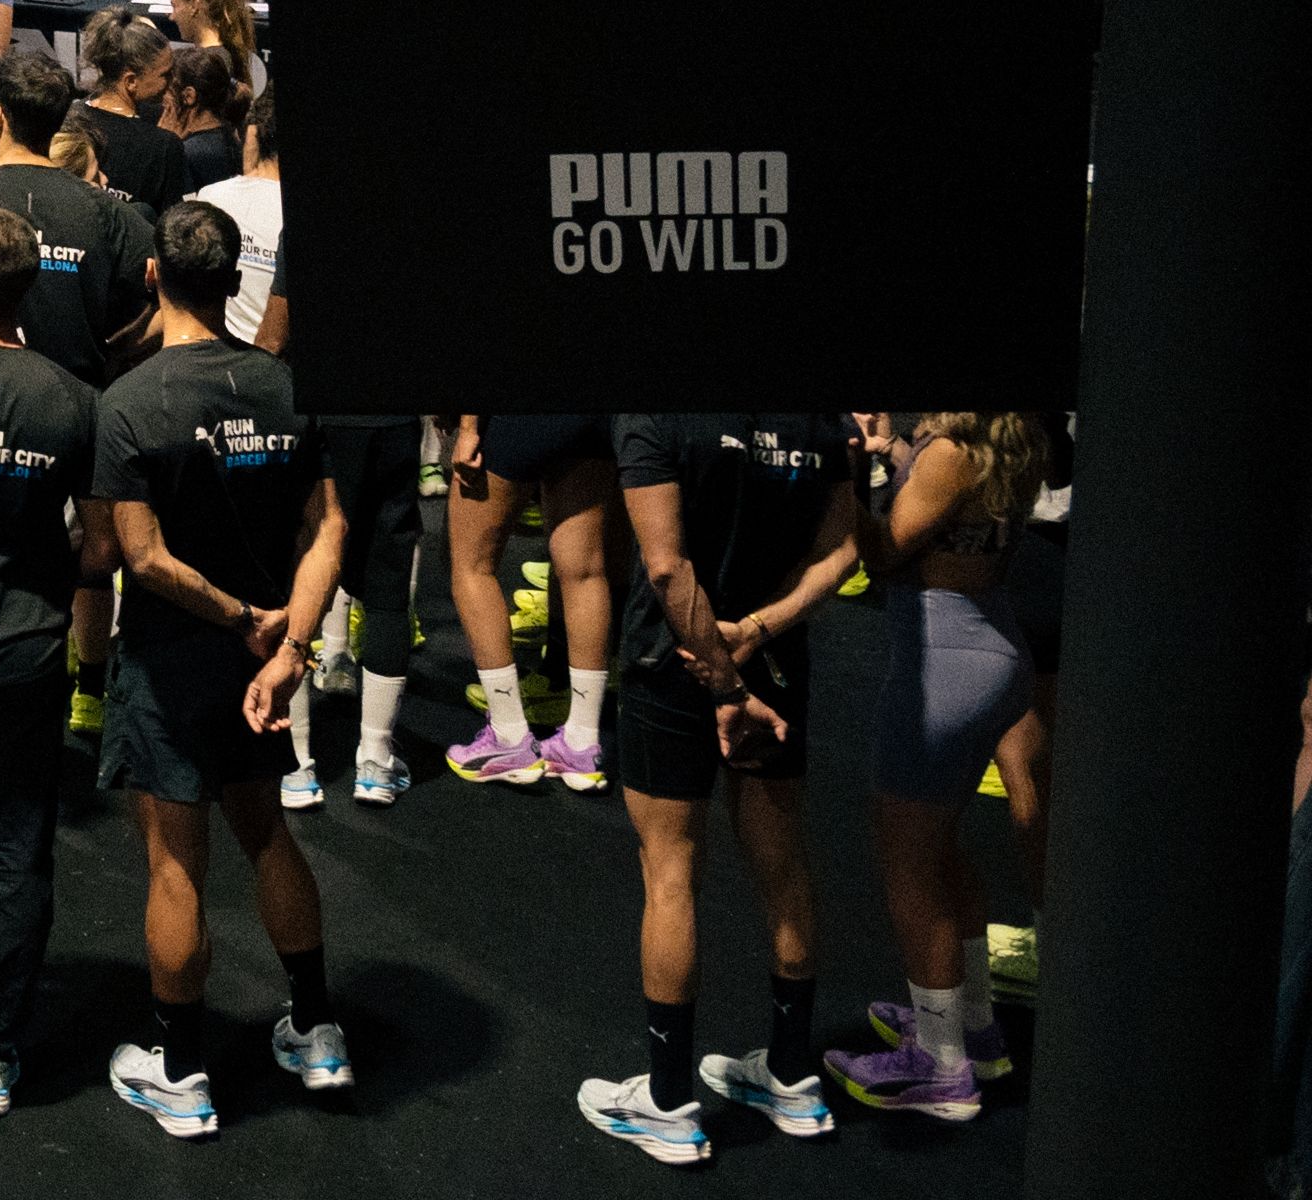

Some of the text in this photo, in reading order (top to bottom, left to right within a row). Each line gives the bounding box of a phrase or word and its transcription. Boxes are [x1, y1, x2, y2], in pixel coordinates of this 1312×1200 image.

[549, 151, 788, 218] PUMA
[53, 246, 86, 263] CITY
[240, 244, 278, 259] OUR CIT
[552, 217, 788, 275] GO WILD
[40, 259, 78, 273] ELONA
[223, 419, 254, 437] RUN
[225, 434, 300, 454] YOUR CITY
[14, 449, 56, 469] CITY
[789, 450, 824, 469] CTY
